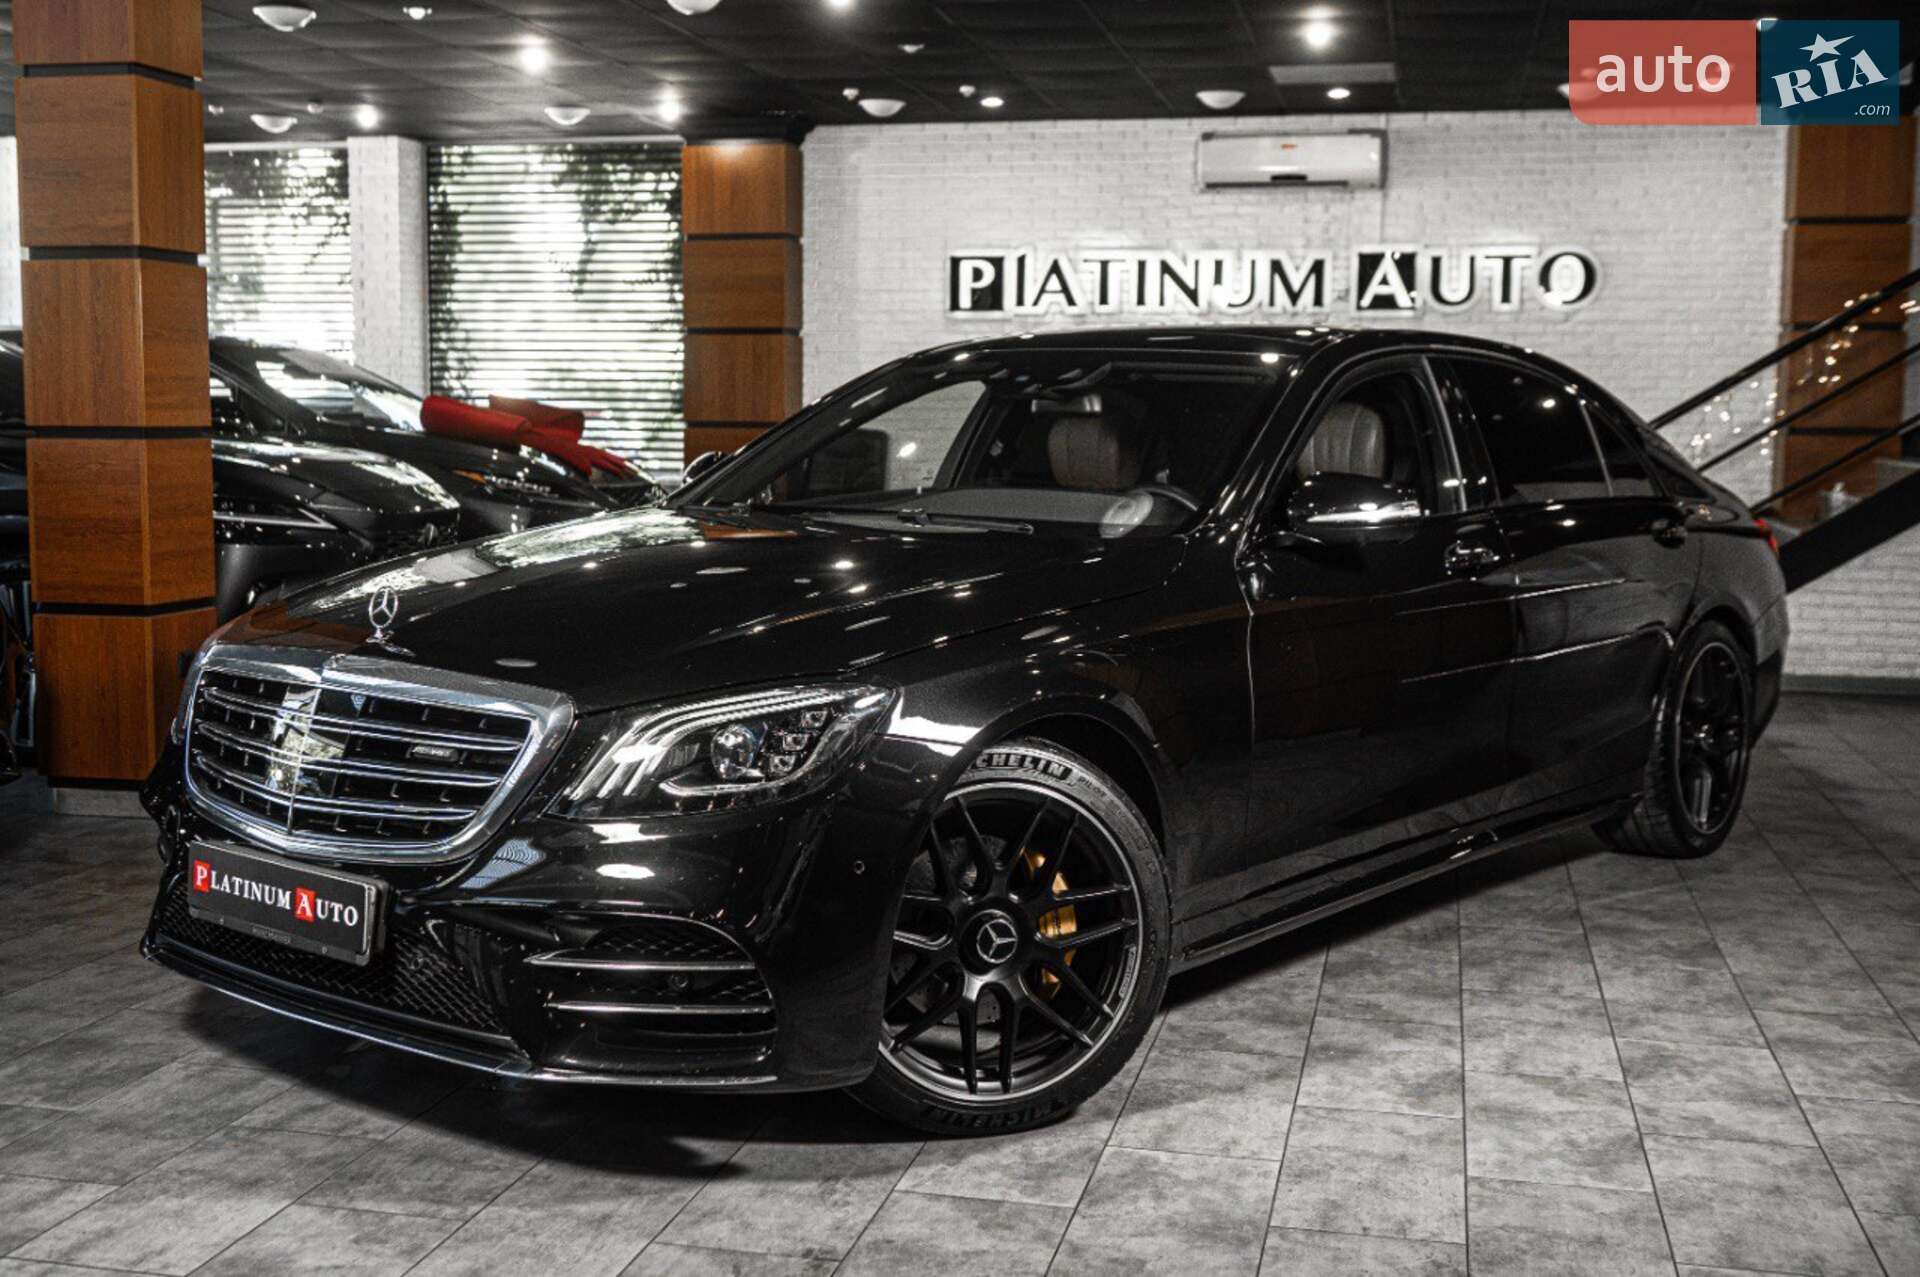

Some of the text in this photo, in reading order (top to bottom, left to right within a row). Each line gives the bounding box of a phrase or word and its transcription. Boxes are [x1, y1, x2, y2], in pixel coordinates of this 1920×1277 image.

[950, 253, 1597, 312] PLATINUM AUTO
[975, 753, 1072, 778] CHELIN
[195, 862, 359, 928] PLATINUM AUTO
